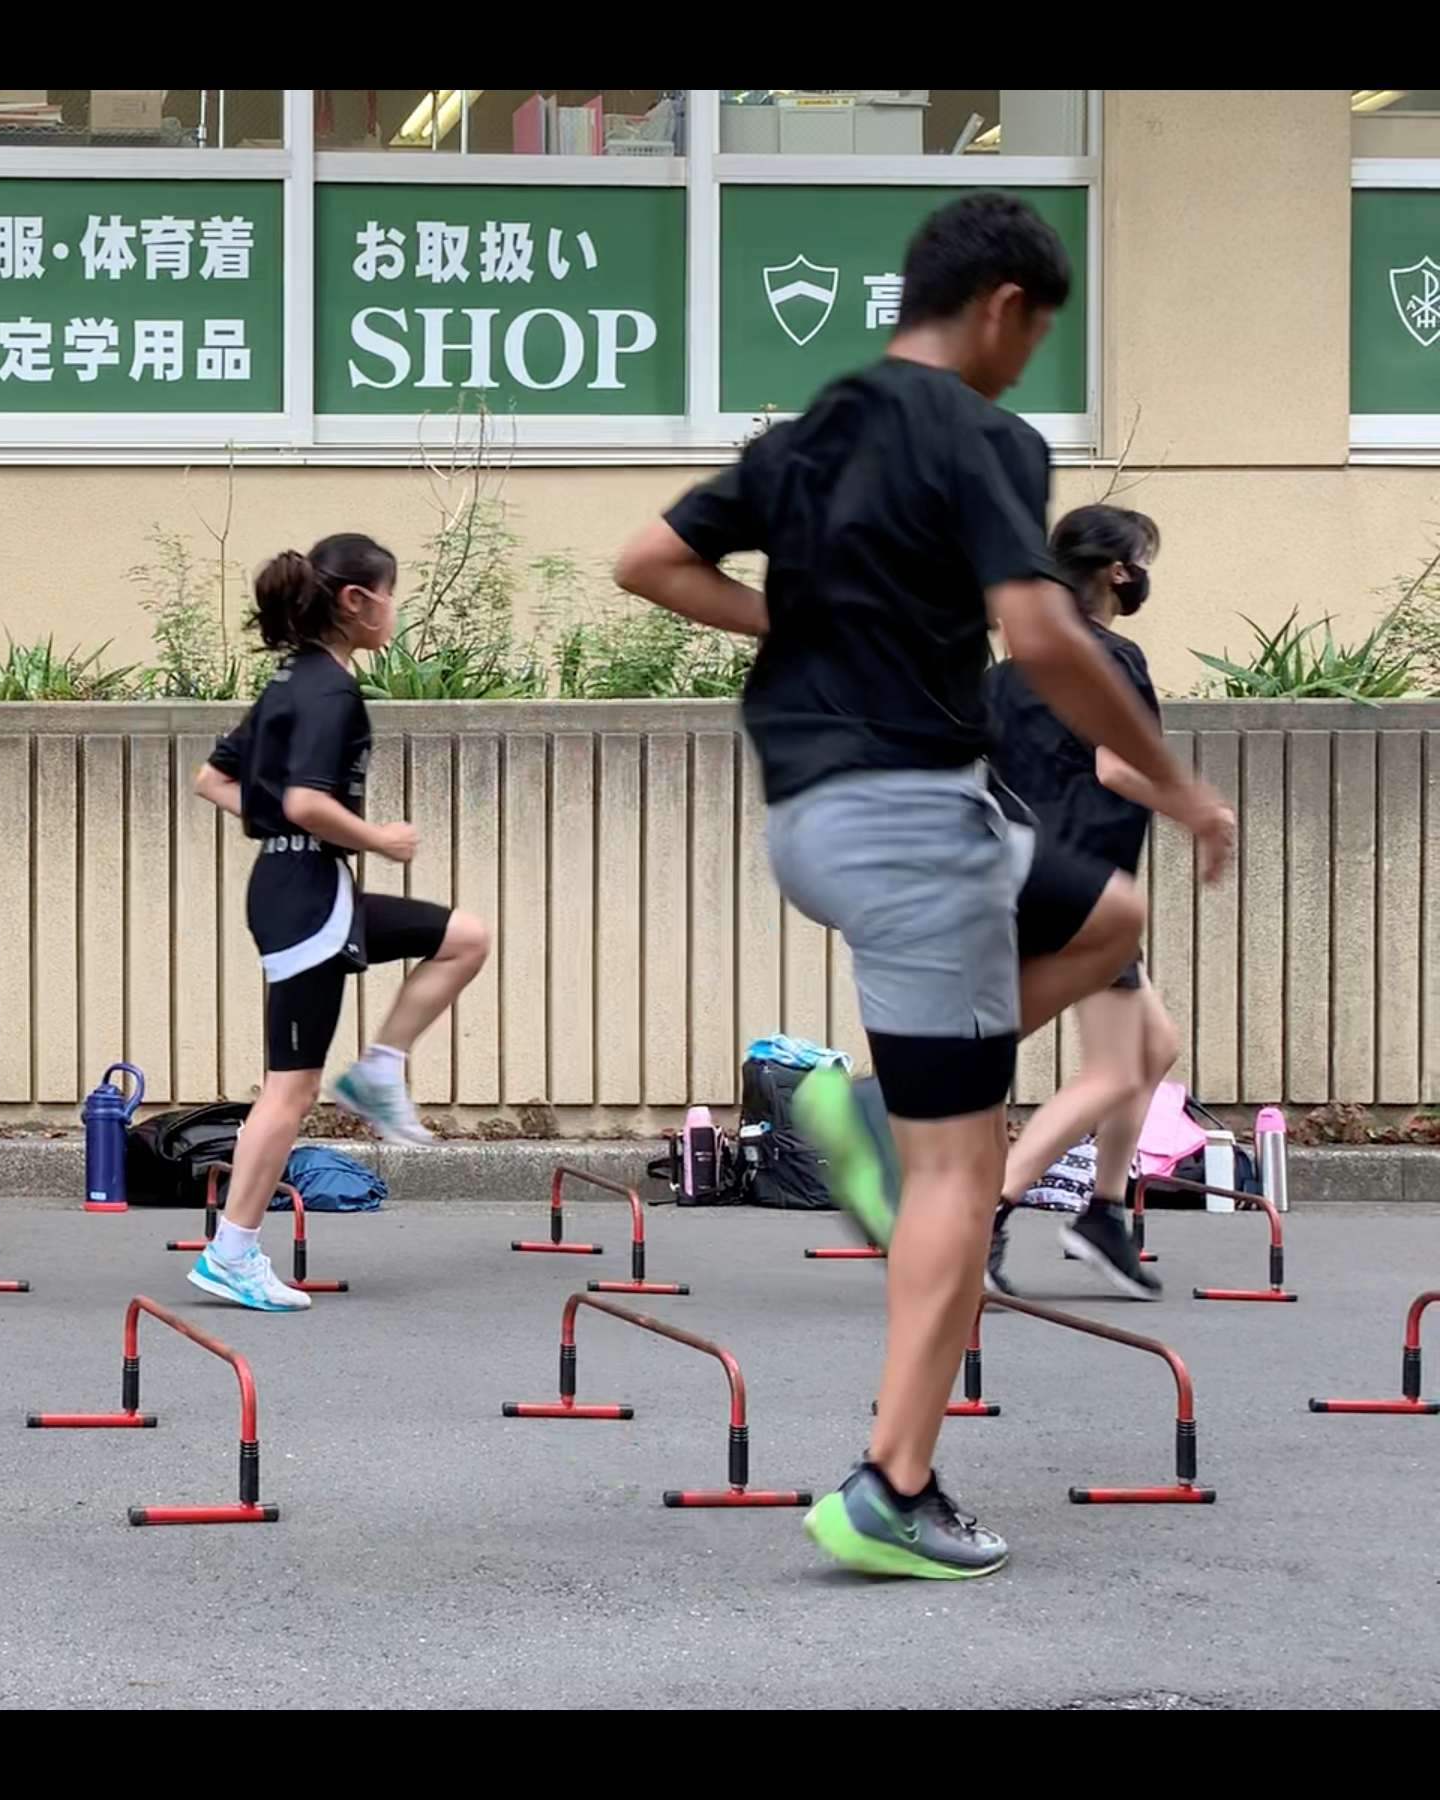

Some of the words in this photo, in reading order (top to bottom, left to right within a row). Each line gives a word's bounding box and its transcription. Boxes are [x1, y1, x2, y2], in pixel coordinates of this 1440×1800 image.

[353, 221, 598, 283] お取扱い
[348, 307, 657, 389] SHOP
